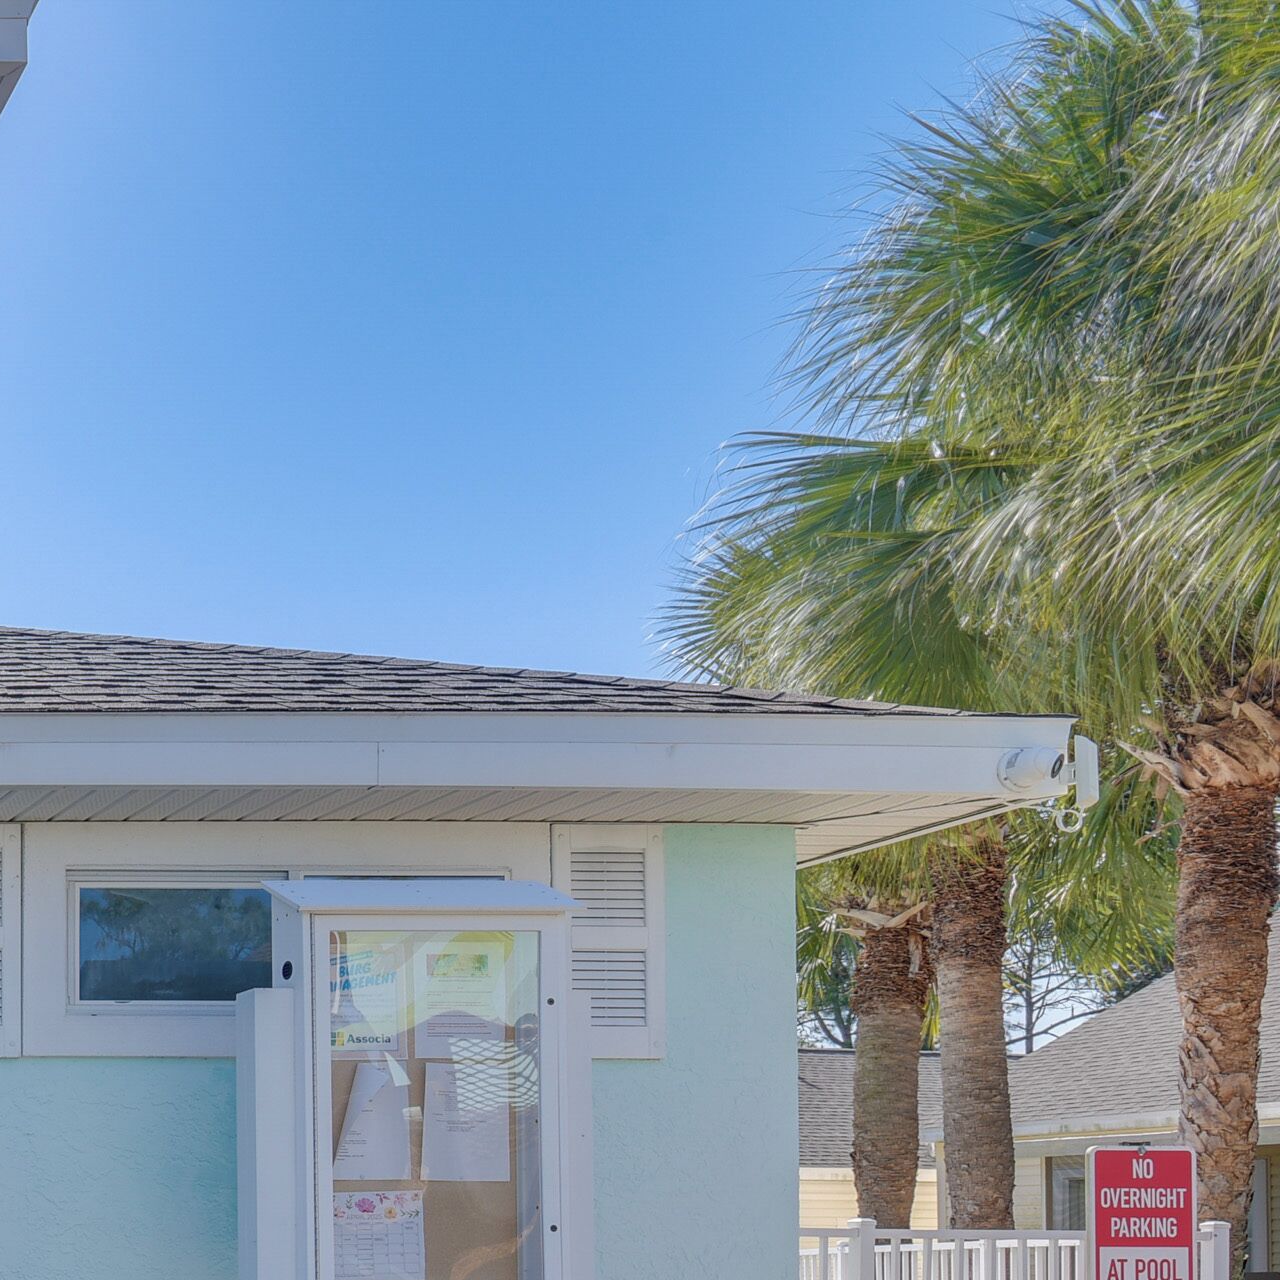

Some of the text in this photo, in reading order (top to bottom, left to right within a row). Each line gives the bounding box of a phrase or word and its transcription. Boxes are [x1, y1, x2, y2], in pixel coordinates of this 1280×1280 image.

[347, 1033, 391, 1044] Associa
[1131, 1158, 1154, 1180] NO
[1100, 1188, 1187, 1209] OVERNIGHT
[1110, 1217, 1178, 1238] PARKING
